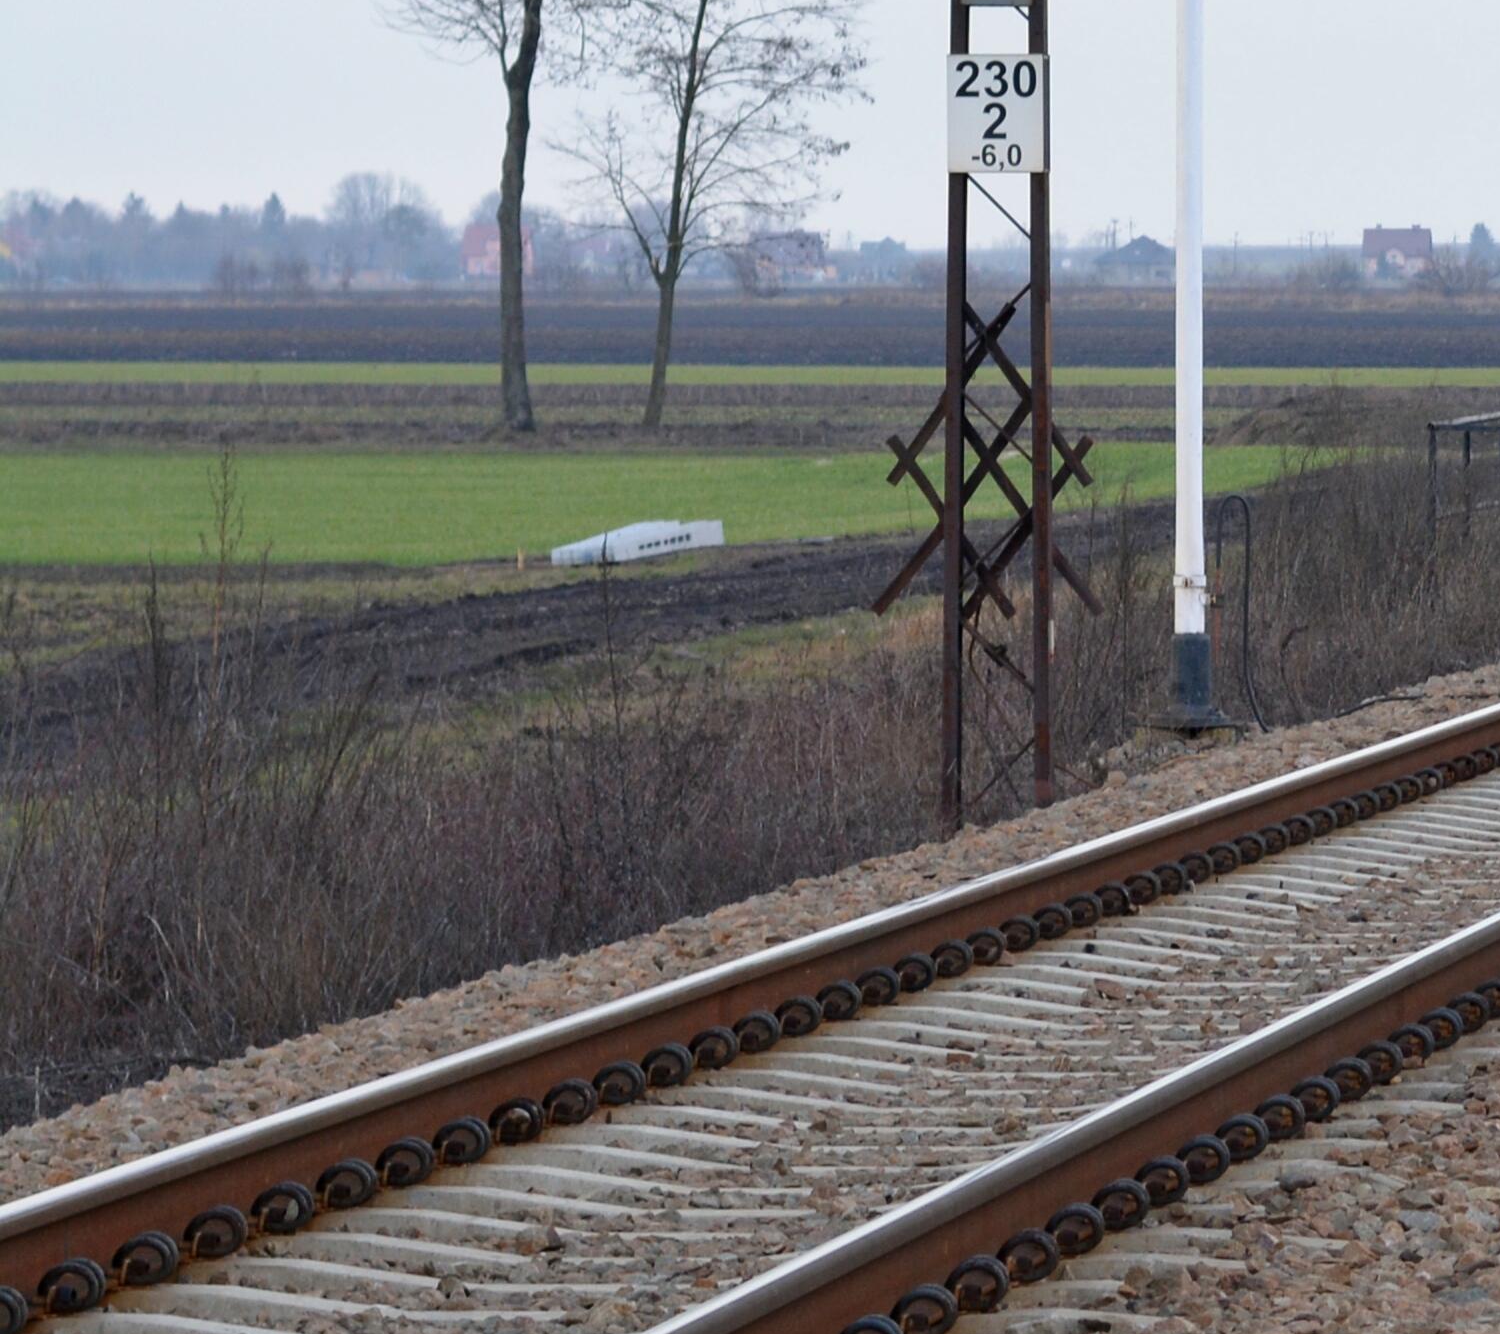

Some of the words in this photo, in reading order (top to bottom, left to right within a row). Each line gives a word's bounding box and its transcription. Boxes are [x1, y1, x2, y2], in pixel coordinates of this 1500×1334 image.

[955, 60, 1037, 98] 230
[982, 102, 1007, 140] 2
[971, 143, 1022, 172] -6,0
